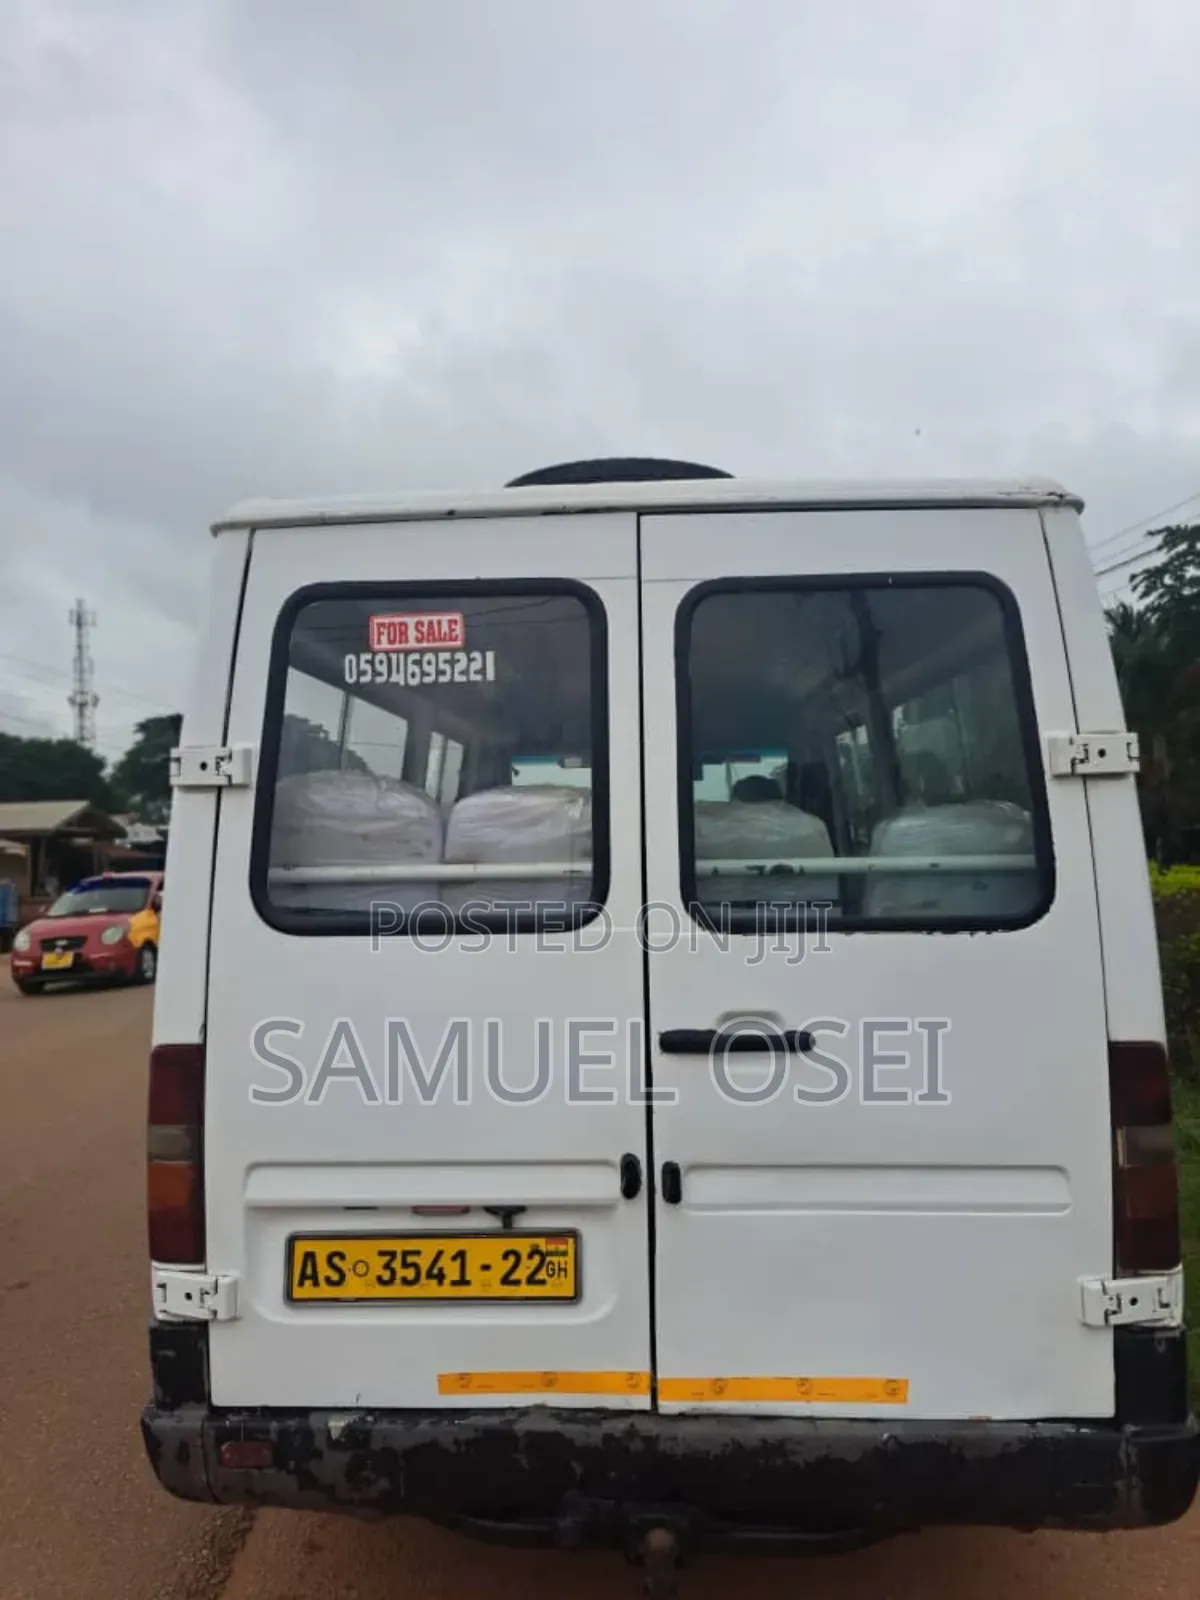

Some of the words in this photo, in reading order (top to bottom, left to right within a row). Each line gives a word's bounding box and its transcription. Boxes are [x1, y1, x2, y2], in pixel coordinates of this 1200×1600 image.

[375, 621, 409, 645] FOR
[414, 618, 459, 643] SALE
[344, 650, 495, 686] 0594695221
[297, 1251, 347, 1288] AS
[545, 1261, 568, 1279] GH
